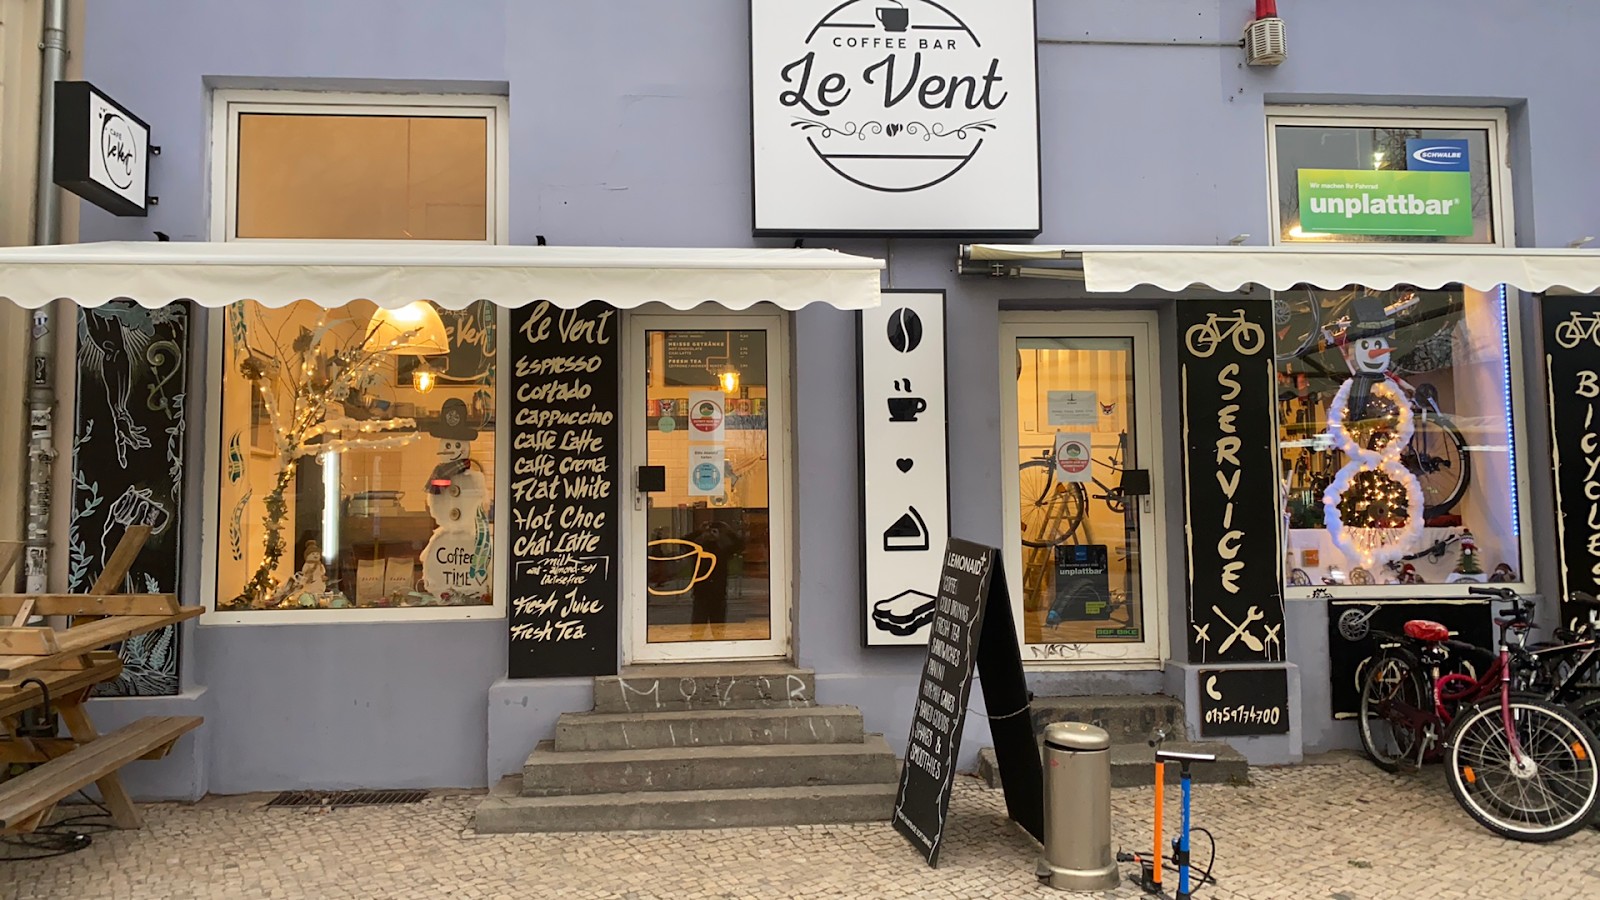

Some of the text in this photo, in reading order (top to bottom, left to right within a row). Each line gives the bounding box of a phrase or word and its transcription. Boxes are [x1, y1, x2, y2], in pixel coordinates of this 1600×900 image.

[832, 37, 957, 50] COFFEE BAR
[779, 51, 1008, 116] Le Vent
[558, 308, 615, 345] Vent
[516, 377, 592, 403] Cortado
[515, 403, 614, 428] Cappuccino
[559, 429, 604, 455] Latte
[559, 456, 610, 474] Crema
[511, 475, 611, 502] Flat White
[1216, 363, 1245, 595] SERVICE
[513, 504, 606, 530] Hot Choc
[513, 530, 600, 557] Chai Latte
[539, 553, 582, 566] milk
[1059, 568, 1103, 576] unplattbar
[513, 587, 604, 618] Fresh Juice
[510, 620, 587, 642] Fresh Tea
[930, 637, 961, 668] SANDWICHES
[932, 708, 950, 735] GOODS
[1205, 705, 1280, 725] 01759174700
[935, 735, 941, 755] &
[909, 742, 941, 780] SMOOTHIES
